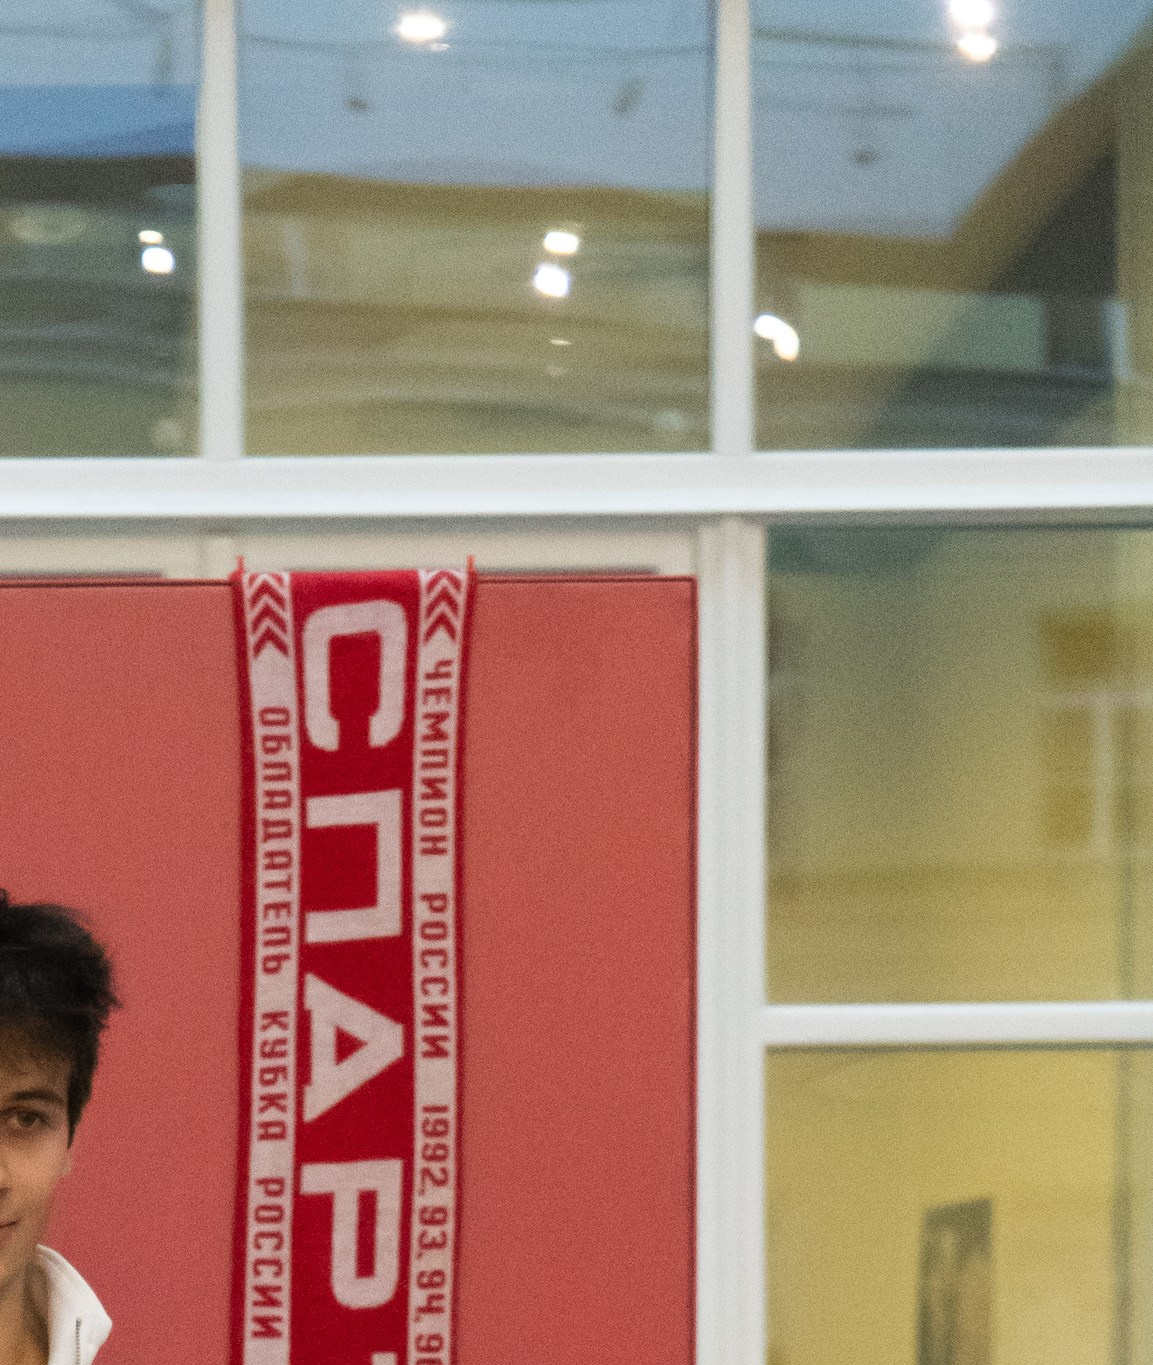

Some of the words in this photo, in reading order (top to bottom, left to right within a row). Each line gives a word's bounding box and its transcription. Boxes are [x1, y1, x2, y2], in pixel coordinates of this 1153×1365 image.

[259, 706, 293, 976] ОБЛАДАТЕЛЬ
[419, 659, 454, 857] ЧЕМПИОН
[419, 893, 450, 1060] РОССИИ
[256, 1010, 289, 1143] КУБКА
[251, 1176, 286, 1340] РОССИИ
